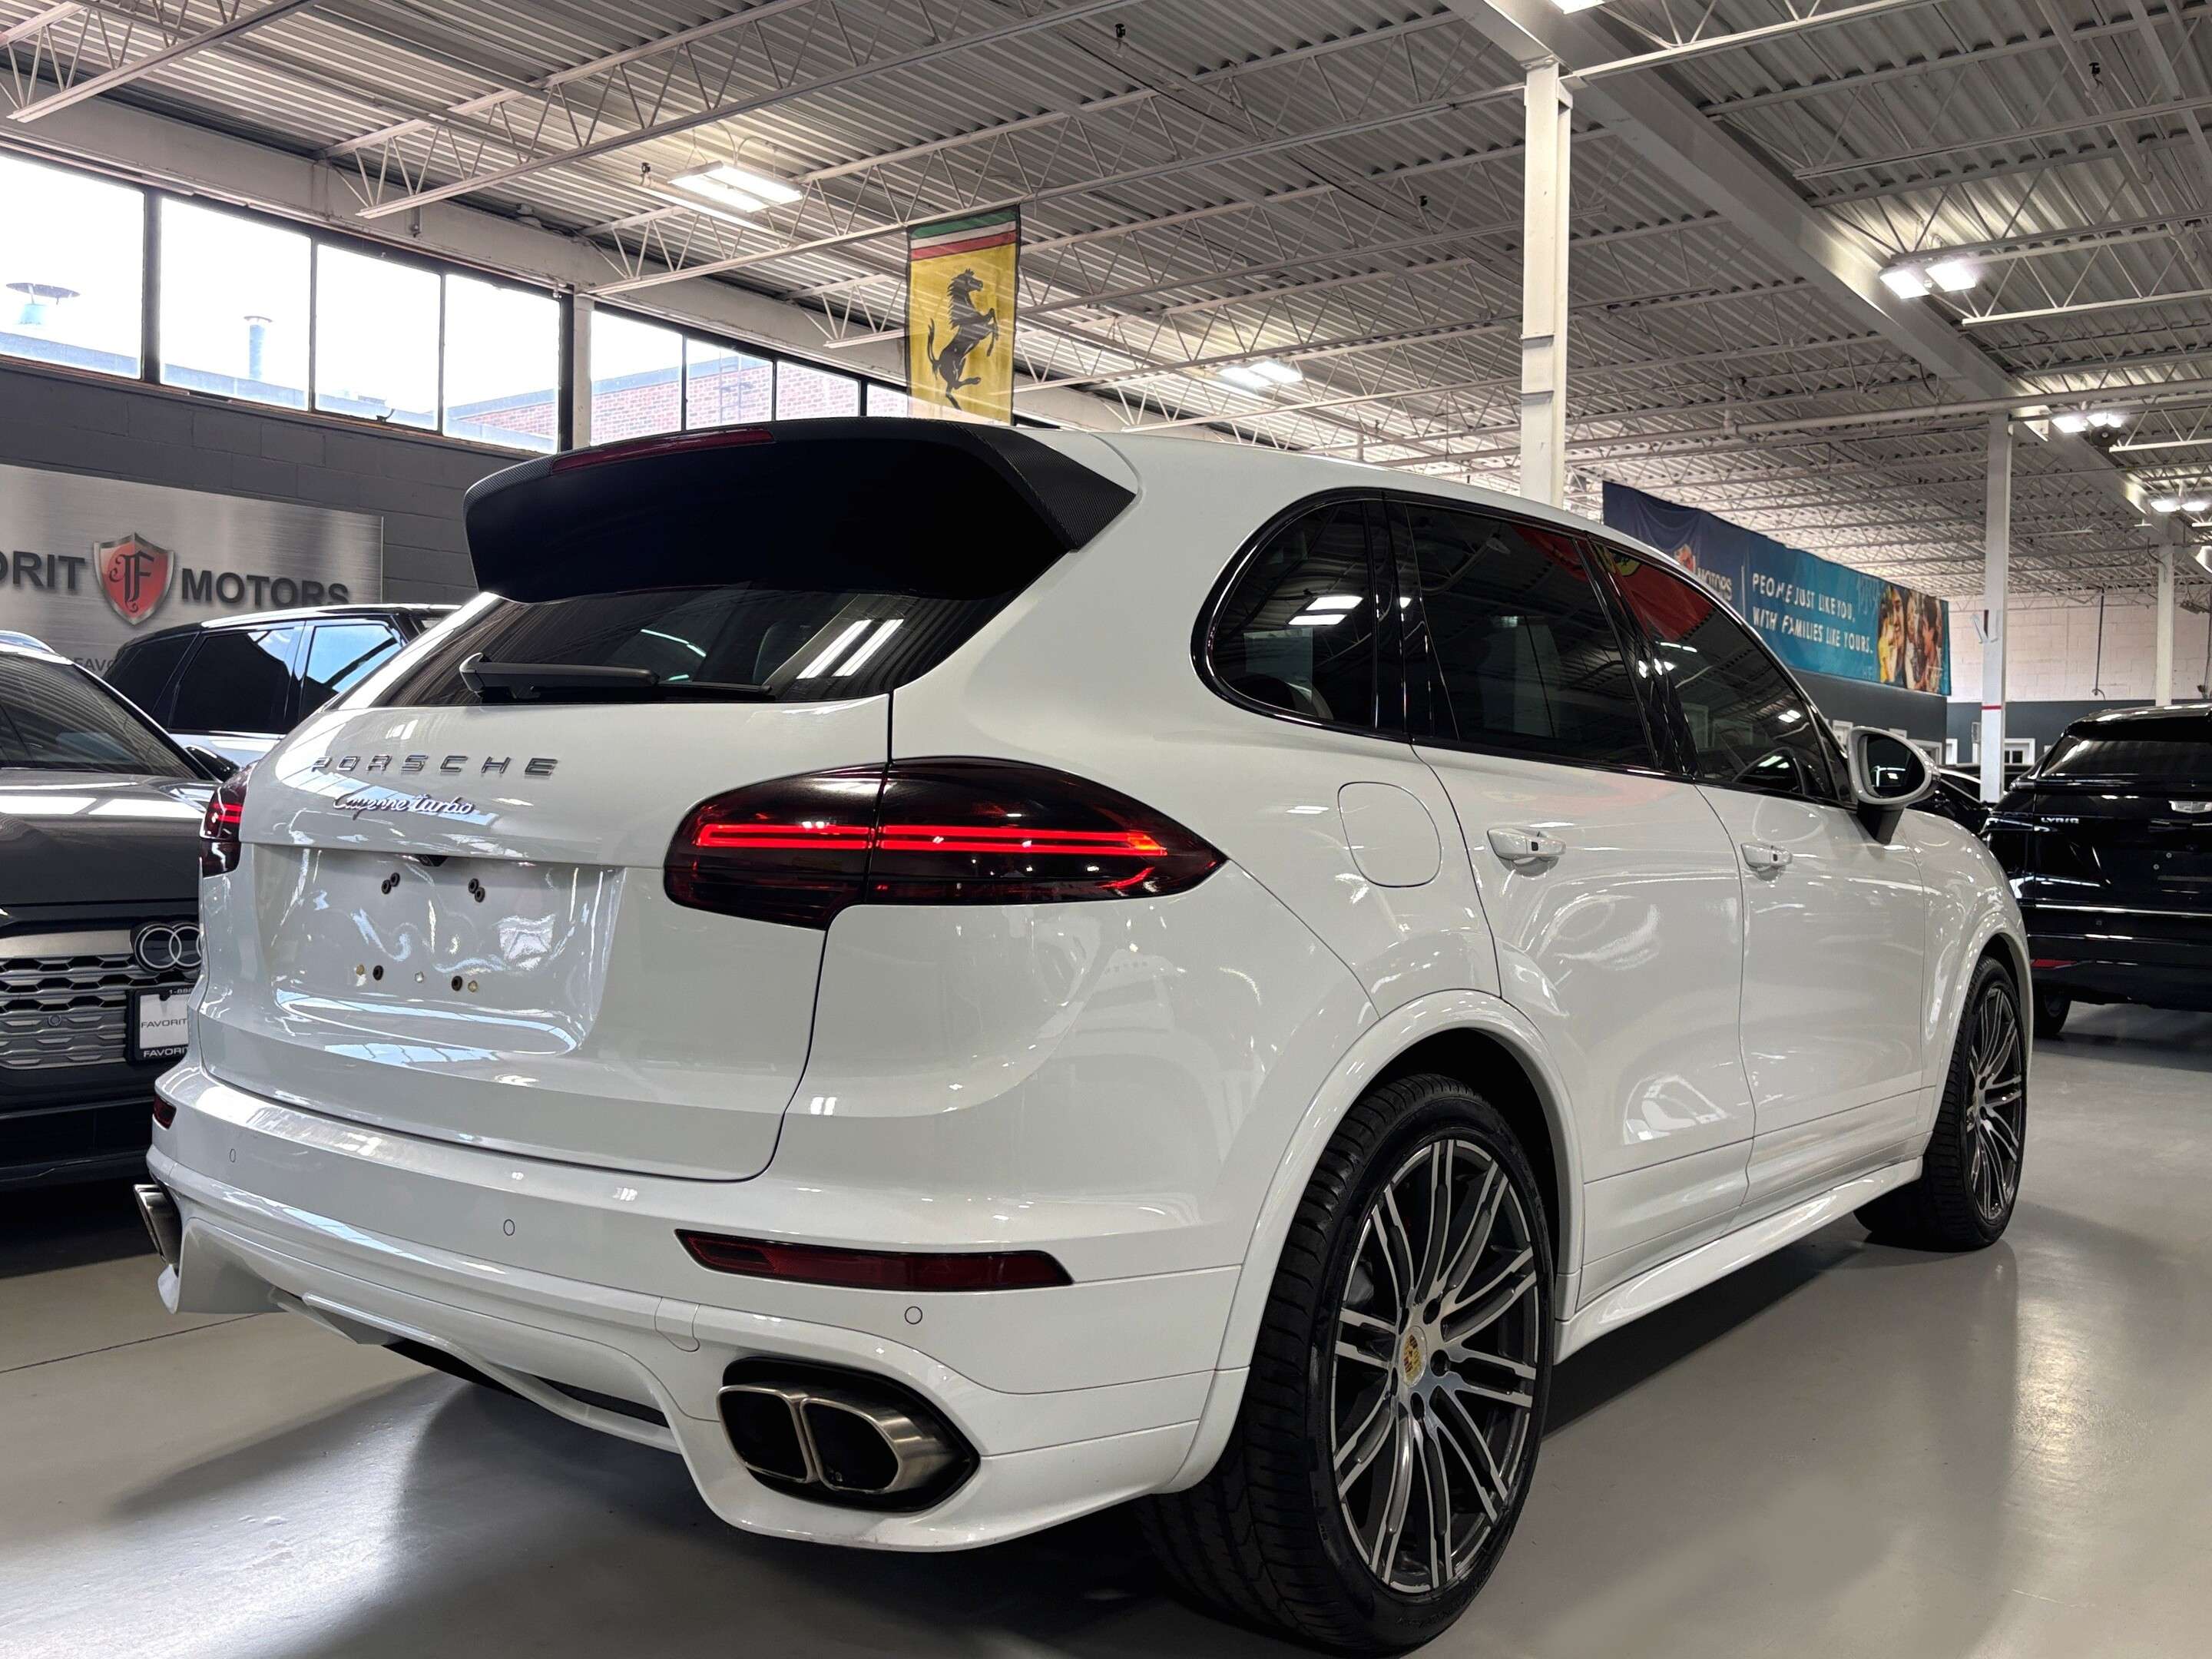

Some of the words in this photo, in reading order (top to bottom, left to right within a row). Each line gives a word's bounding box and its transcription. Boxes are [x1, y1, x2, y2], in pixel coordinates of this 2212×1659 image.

[0, 550, 85, 590] RIT
[181, 568, 349, 608] MOTORS
[1697, 567, 1733, 601] MOTORS
[1793, 587, 1815, 609] JUST
[1818, 593, 1836, 615] LIKE
[1752, 606, 1778, 631] WITH
[1781, 614, 1823, 643] FAMILIES
[1826, 626, 1841, 647] LIKE
[1843, 631, 1873, 654] YOURS.
[311, 753, 558, 776] PORSCHE
[333, 783, 410, 820] Cayenne
[413, 793, 475, 814] turbo
[141, 1018, 187, 1028] FAVORIT
[143, 1046, 187, 1058] FAVORI
